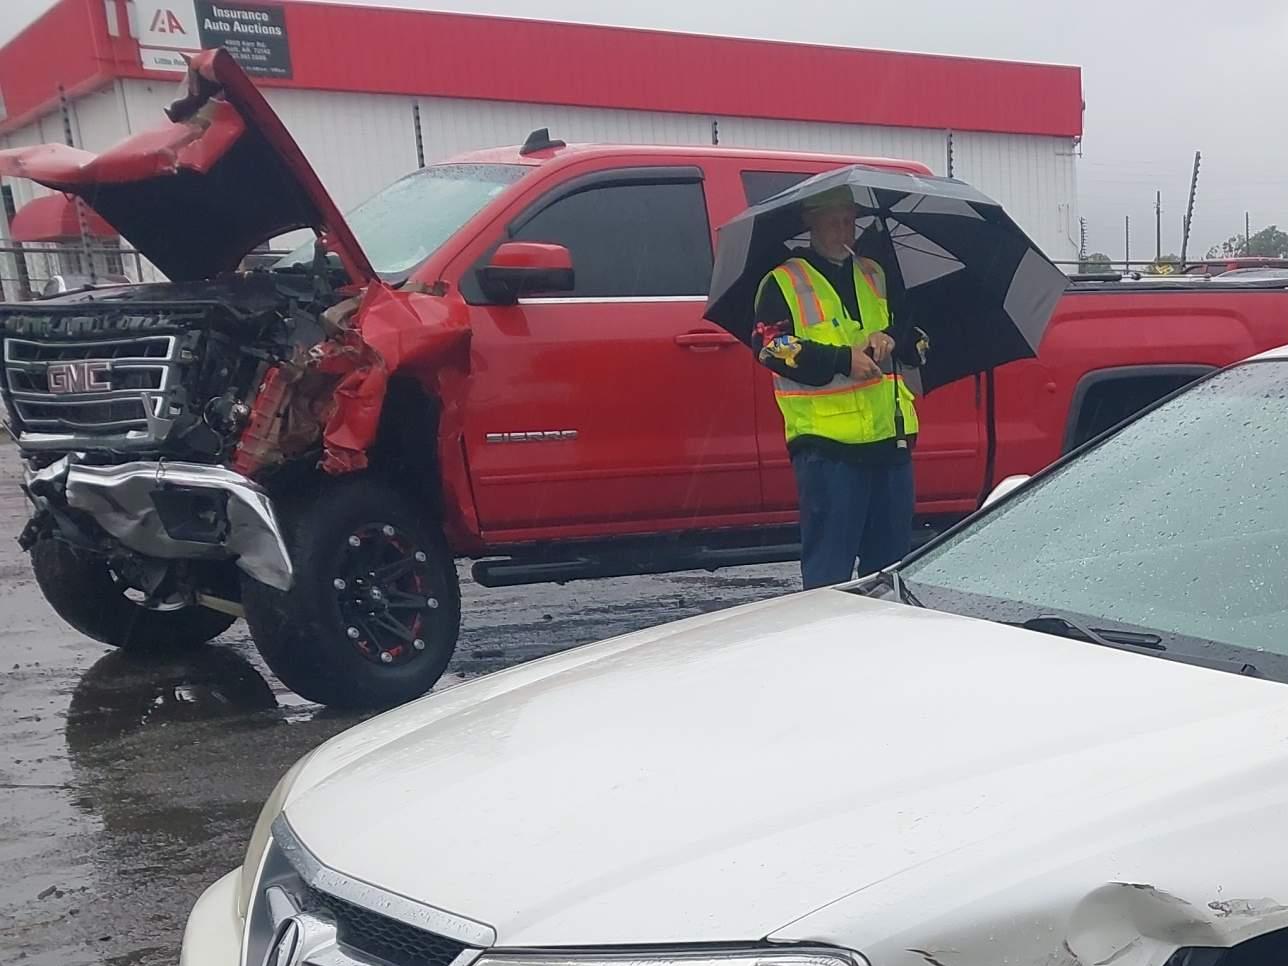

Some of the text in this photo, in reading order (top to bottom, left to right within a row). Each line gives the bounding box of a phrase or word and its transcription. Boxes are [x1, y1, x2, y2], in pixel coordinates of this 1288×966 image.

[212, 5, 269, 21] Insurance
[203, 18, 282, 35] Auto Auctions
[47, 361, 112, 393] GMC
[485, 430, 578, 443] SIERRA
